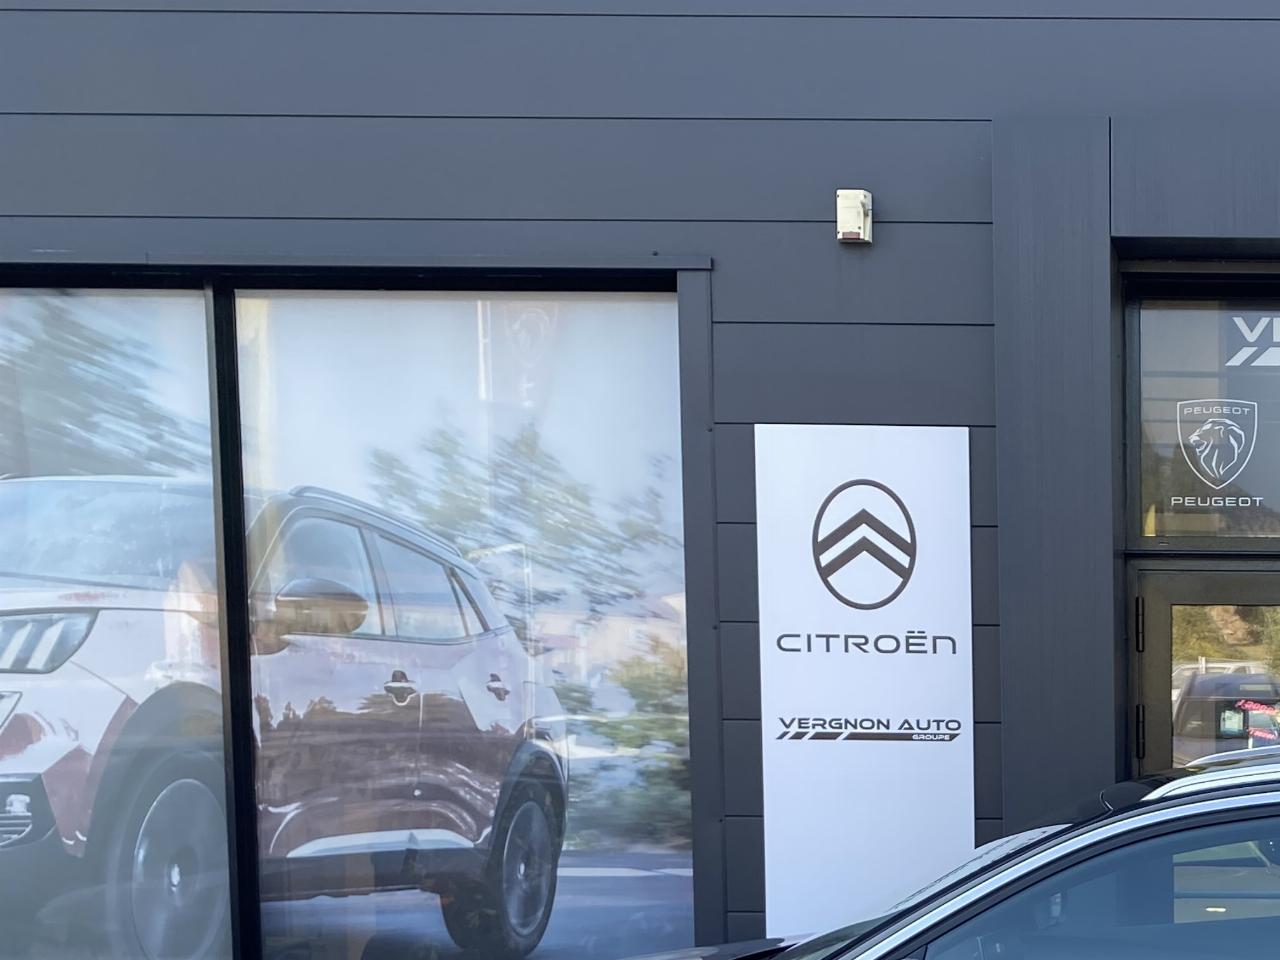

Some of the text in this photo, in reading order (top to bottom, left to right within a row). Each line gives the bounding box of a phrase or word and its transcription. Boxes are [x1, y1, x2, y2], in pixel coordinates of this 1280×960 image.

[1183, 406, 1251, 416] PEUGEOT
[1170, 496, 1264, 507] PEUGEOT
[778, 717, 962, 732] VERGNON AUTO
[912, 733, 951, 741] GROUPE
